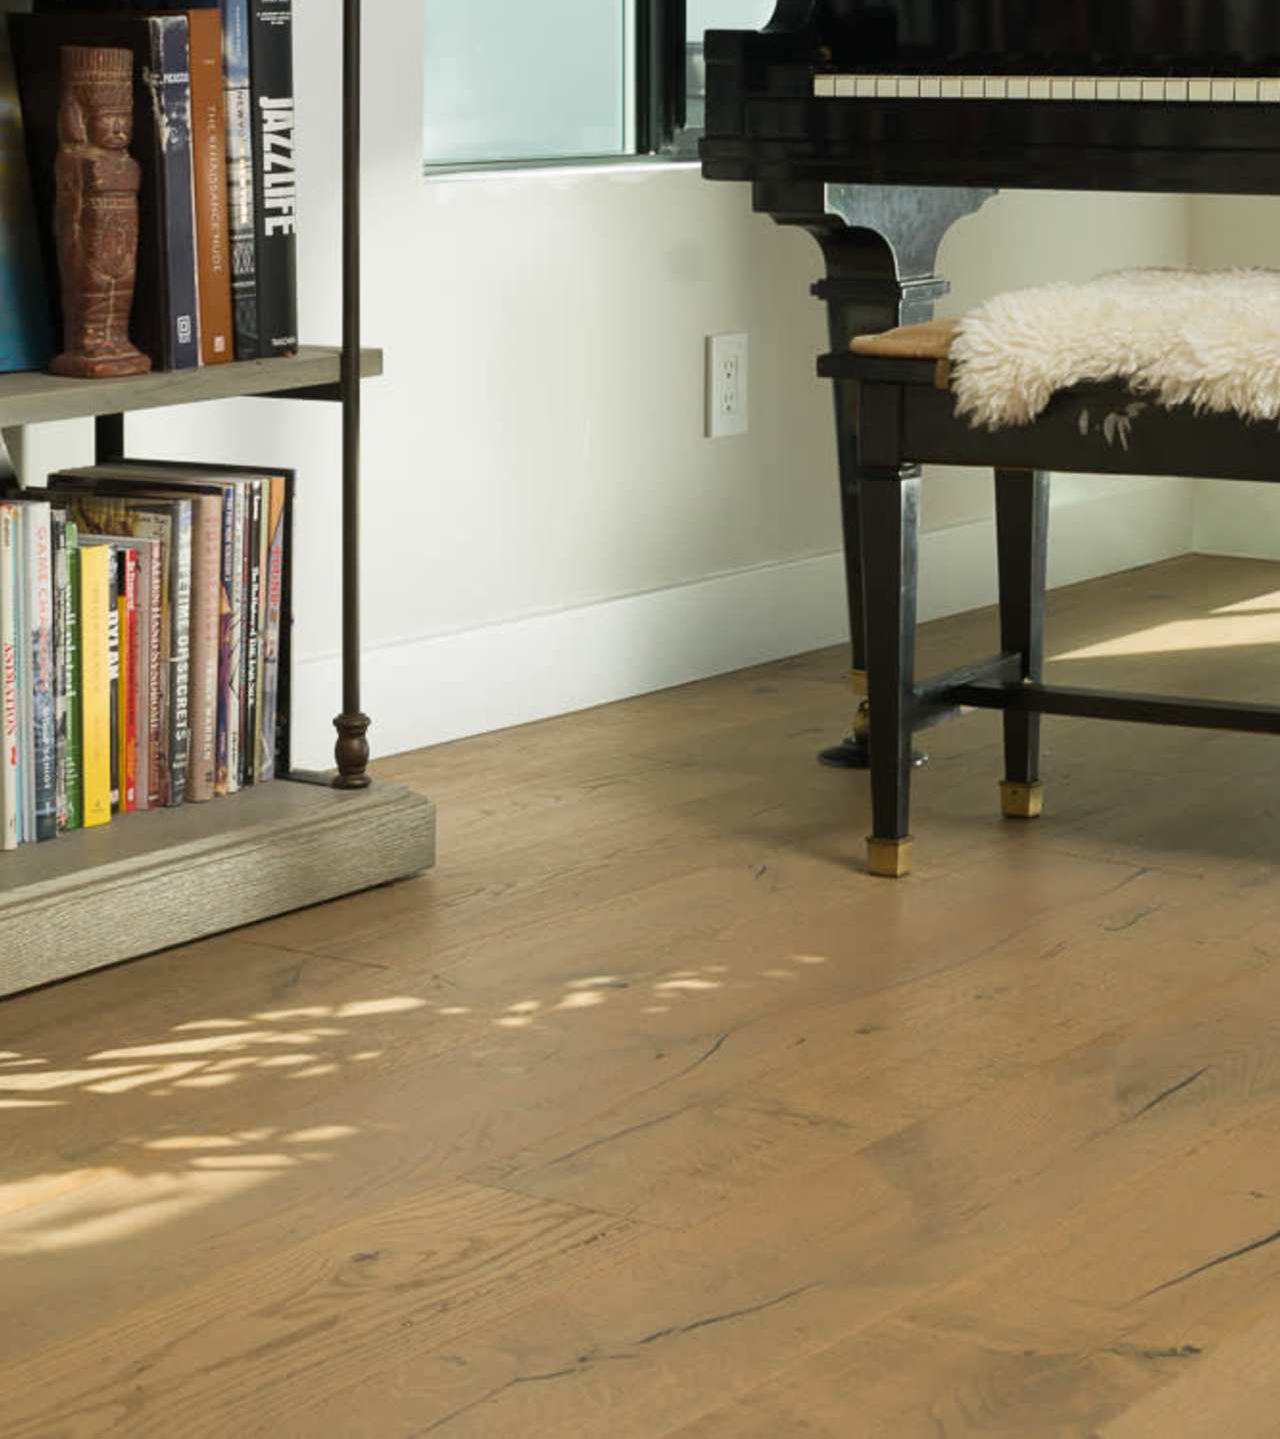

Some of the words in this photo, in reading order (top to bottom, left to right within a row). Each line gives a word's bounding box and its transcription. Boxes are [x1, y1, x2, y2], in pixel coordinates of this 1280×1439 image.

[206, 106, 217, 133] THE
[207, 137, 220, 232] RENAISSANCE
[211, 235, 222, 273] NUDE
[150, 560, 161, 604] ALIEN
[109, 609, 120, 680] DYLAN
[150, 607, 161, 650] HAND
[4, 643, 18, 738] ANIMATION
[149, 651, 161, 731] SYNDROME
[175, 663, 190, 742] SECRETS
